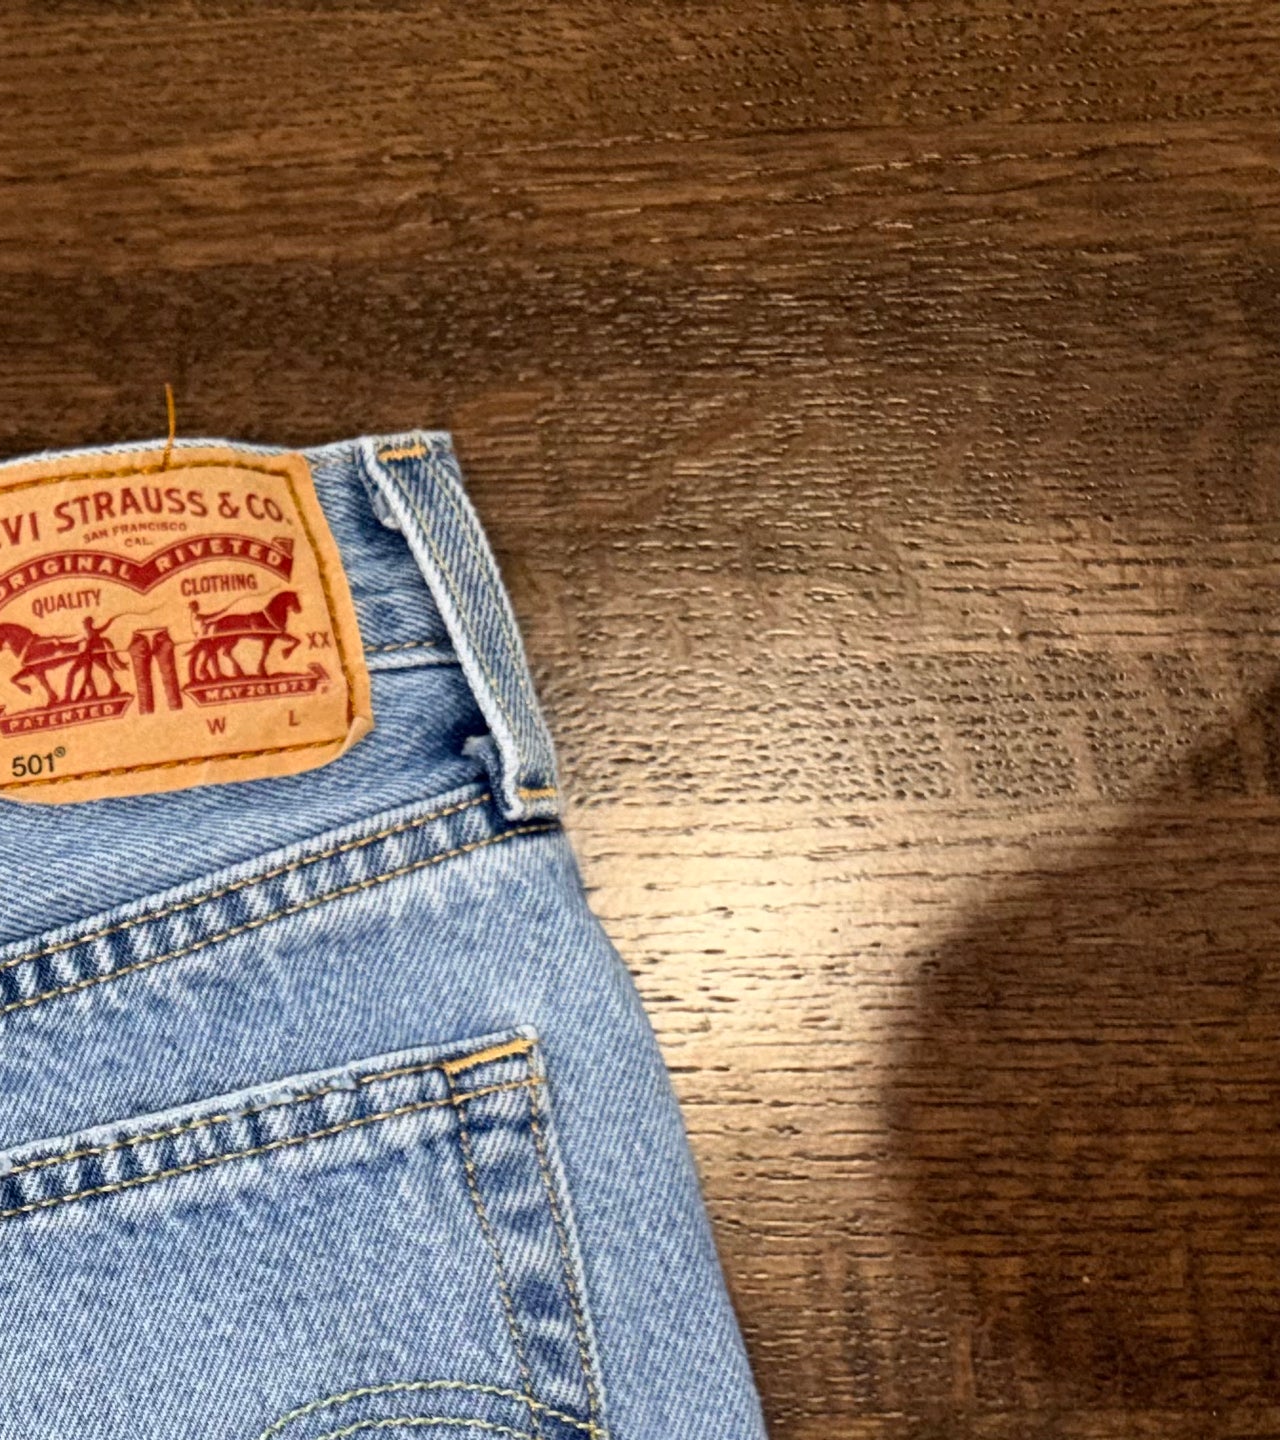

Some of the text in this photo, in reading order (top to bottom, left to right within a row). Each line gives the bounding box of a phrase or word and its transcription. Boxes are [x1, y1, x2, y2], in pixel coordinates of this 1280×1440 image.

[53, 486, 208, 534] STRAUSS
[218, 492, 240, 518] &
[245, 493, 292, 526] CO.
[83, 521, 187, 544] SAN FRANCISCO
[154, 538, 282, 574] RIVETED
[32, 573, 258, 619] QUALITY CLOTHING
[306, 631, 332, 650] XX
[204, 687, 243, 702] MAY
[9, 704, 114, 732] PATENTED
[206, 709, 301, 736] W L
